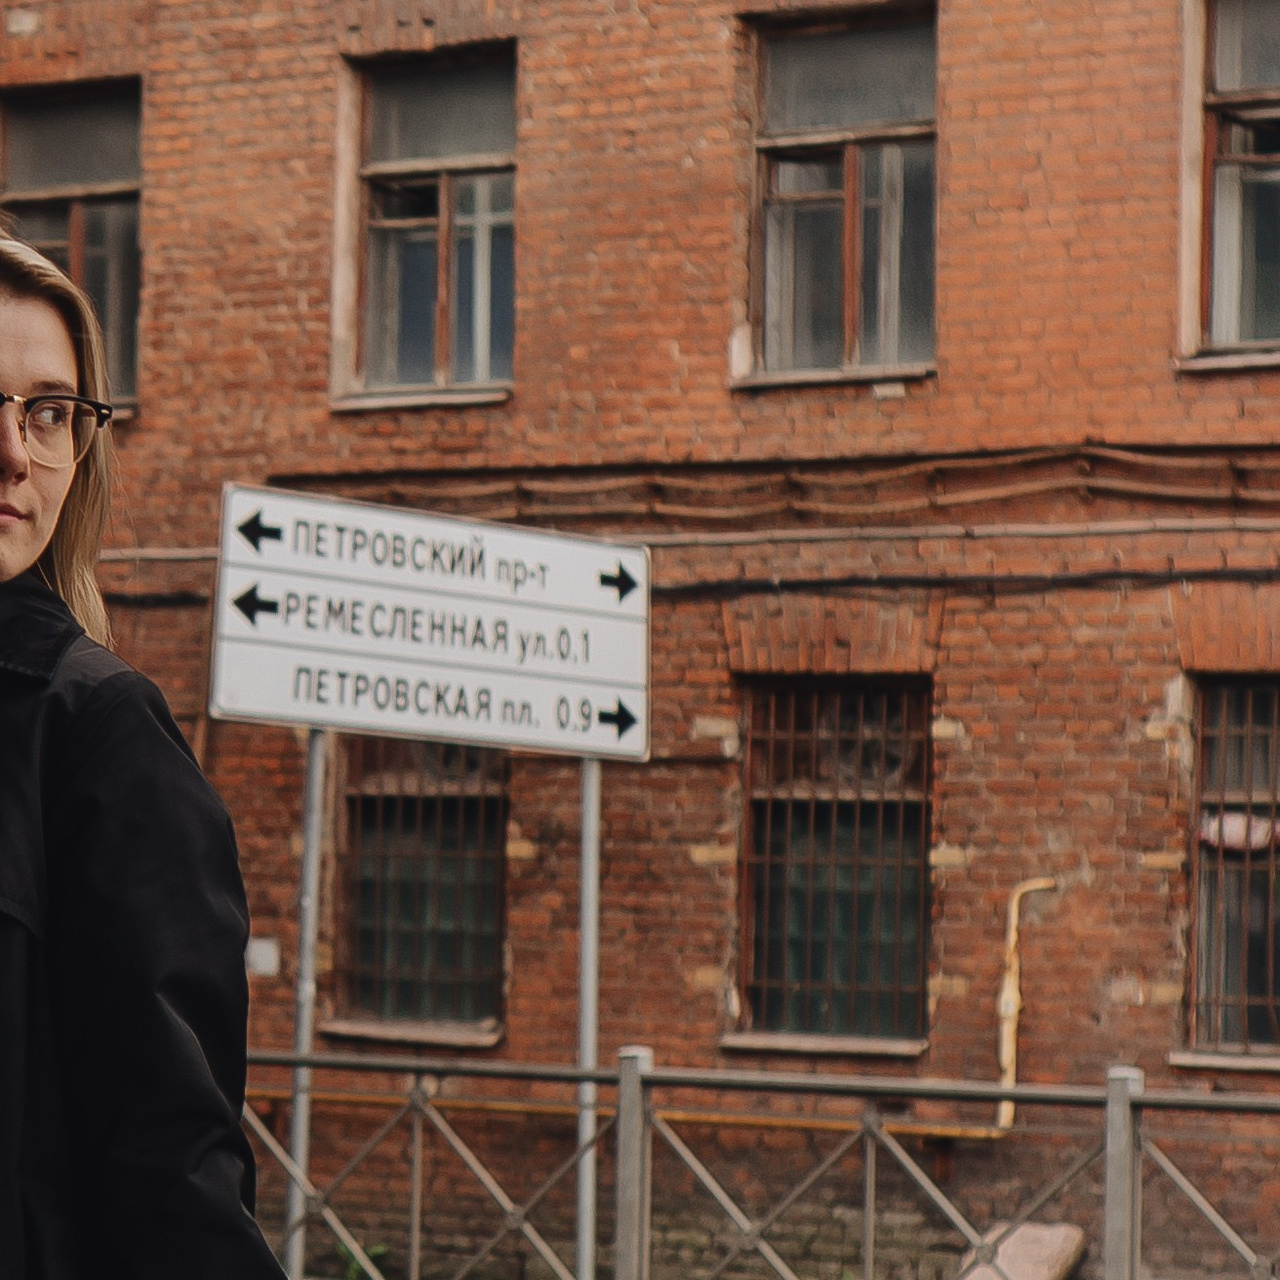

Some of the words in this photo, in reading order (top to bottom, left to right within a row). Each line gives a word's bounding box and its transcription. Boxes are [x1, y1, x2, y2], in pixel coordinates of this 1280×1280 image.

[293, 519, 487, 580] ПЕТРОВСКИЙ
[497, 557, 549, 593] пр-т
[284, 591, 509, 655] РЕМЕСЛЕННАЯ
[294, 666, 492, 721] ПЕТРОВСКАЯ
[503, 699, 540, 728] пл.
[557, 696, 591, 732] 0.9
